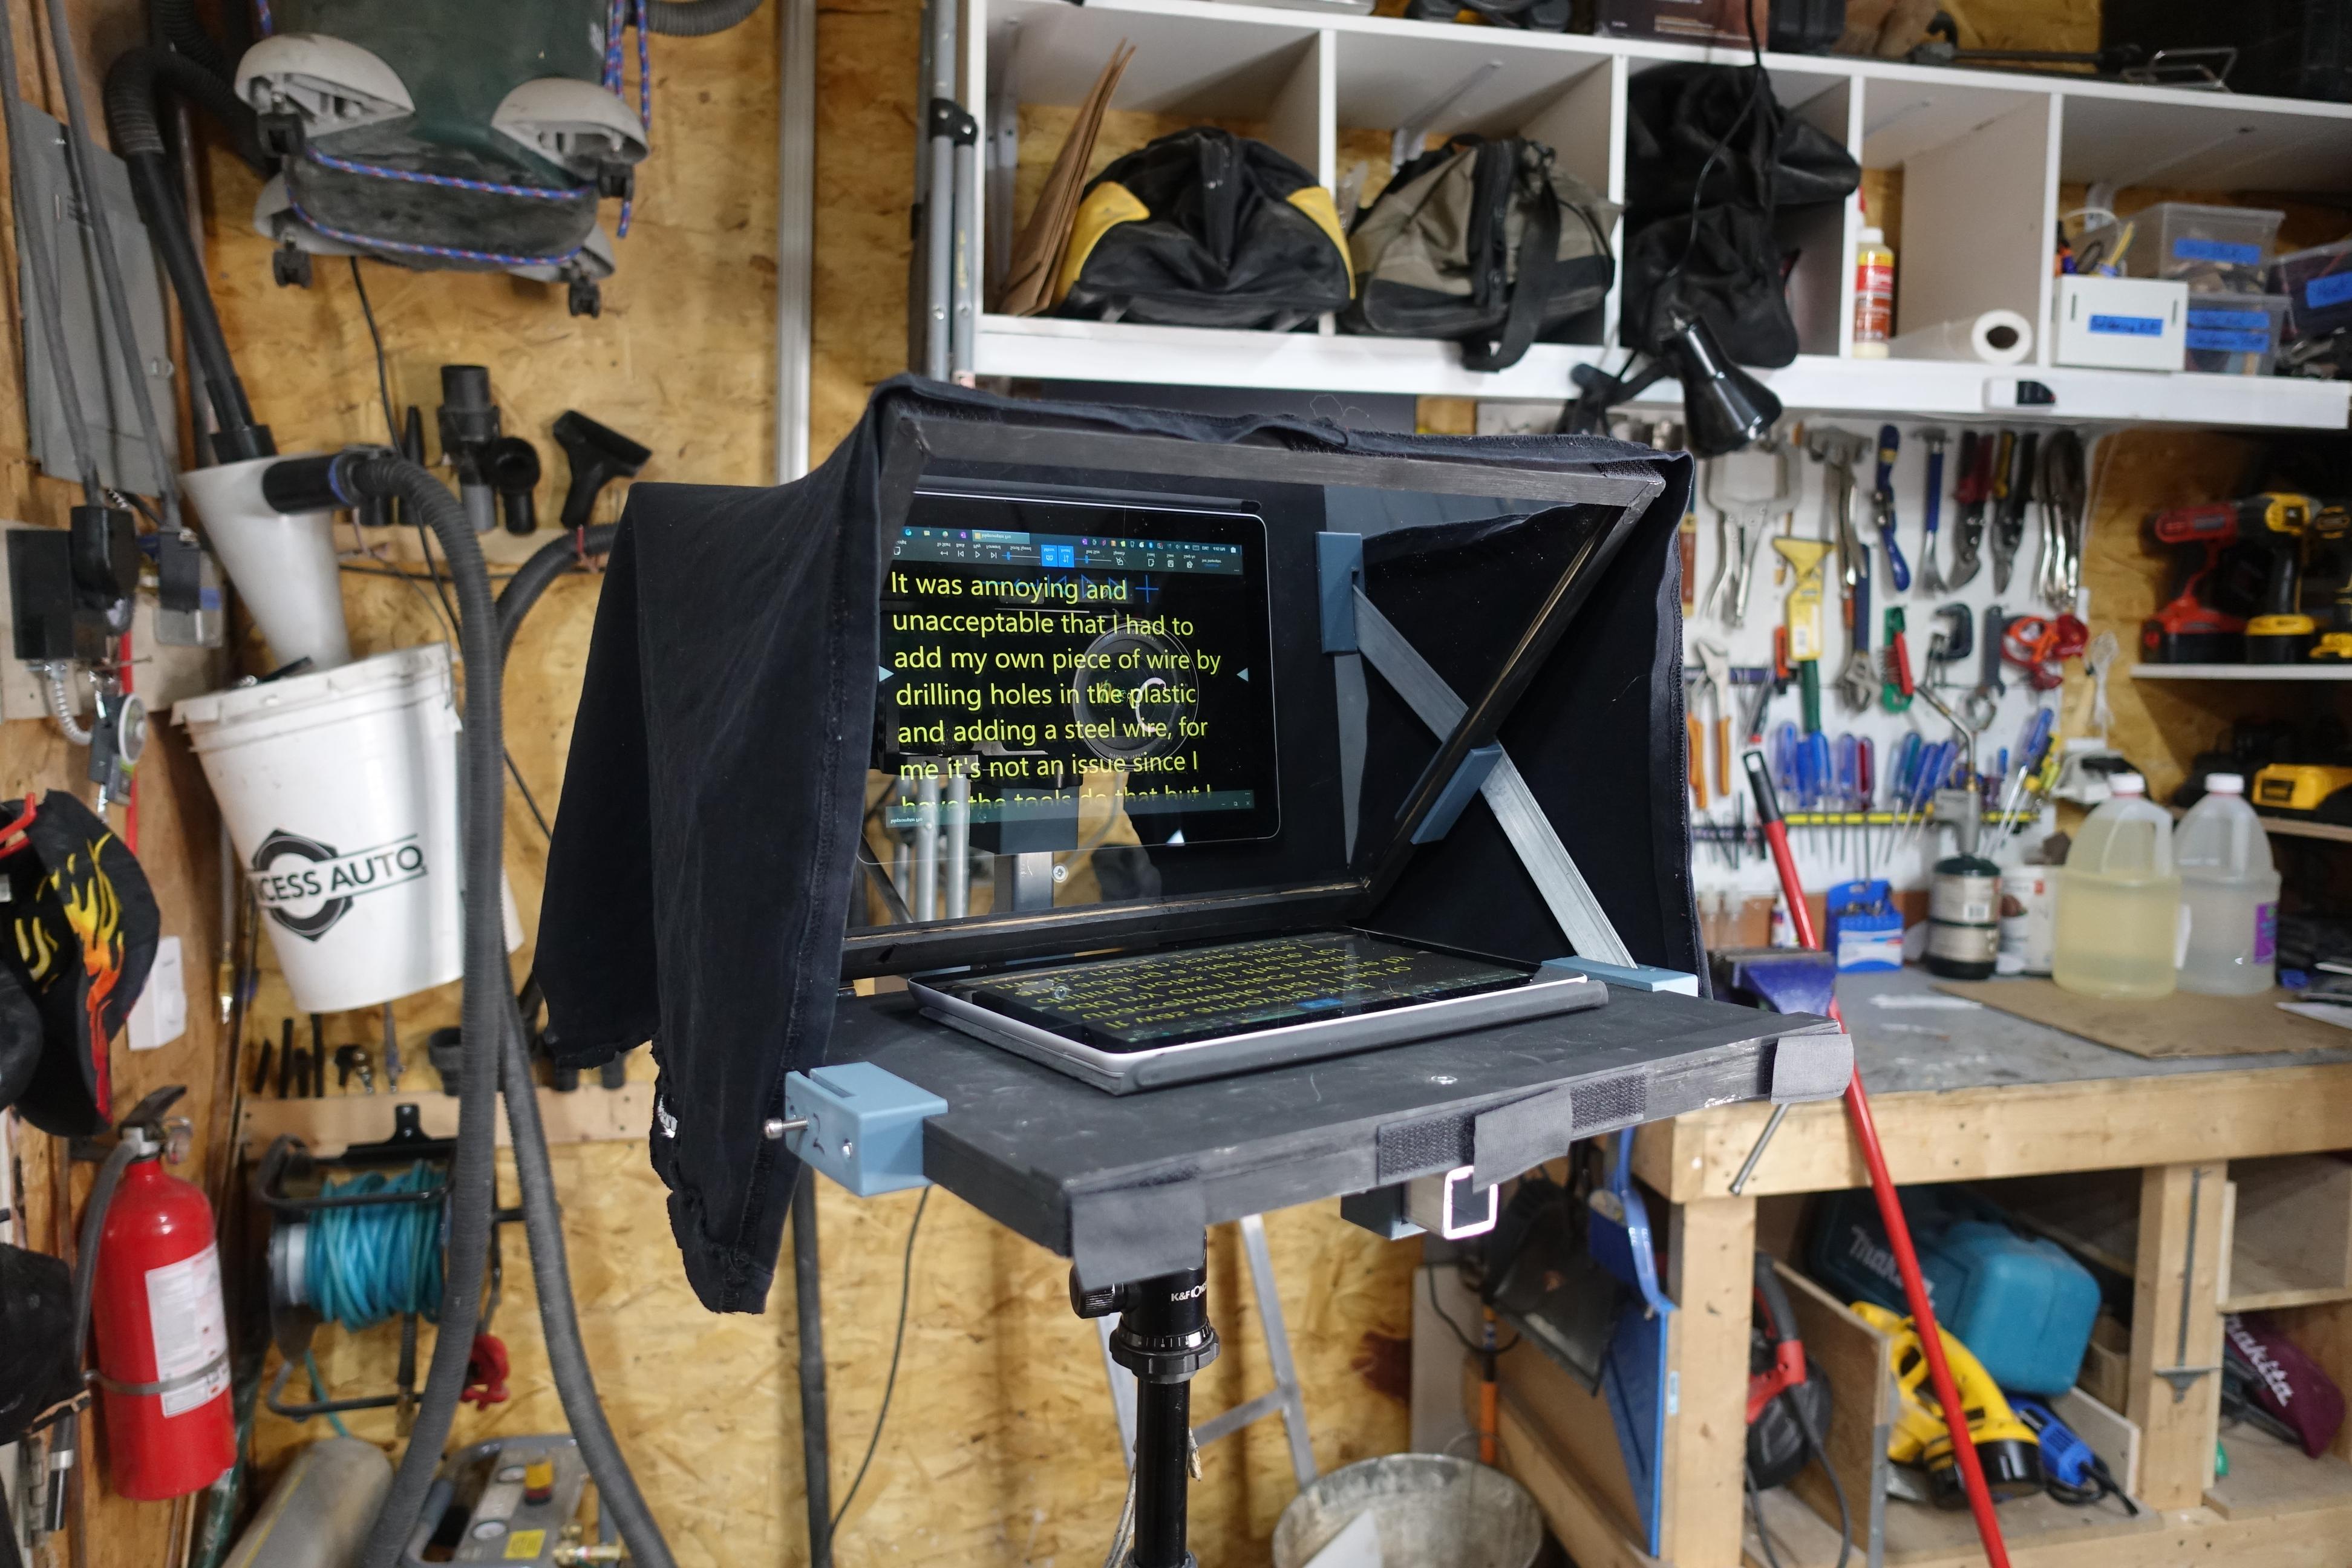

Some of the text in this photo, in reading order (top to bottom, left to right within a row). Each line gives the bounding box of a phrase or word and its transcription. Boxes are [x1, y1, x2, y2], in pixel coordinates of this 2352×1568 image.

[891, 571, 1126, 604] It was annoying and
[893, 611, 1194, 638] unacceptable that I had to
[895, 645, 1221, 675] add my own piece of wire by
[897, 682, 1197, 711] drilling holes in the plastic
[898, 716, 1209, 746] and adding a steel wire, for
[901, 751, 1198, 780] me it's not an issue since I
[258, 844, 423, 902] CESS AUTO
[1171, 1290, 1191, 1302] K&F
